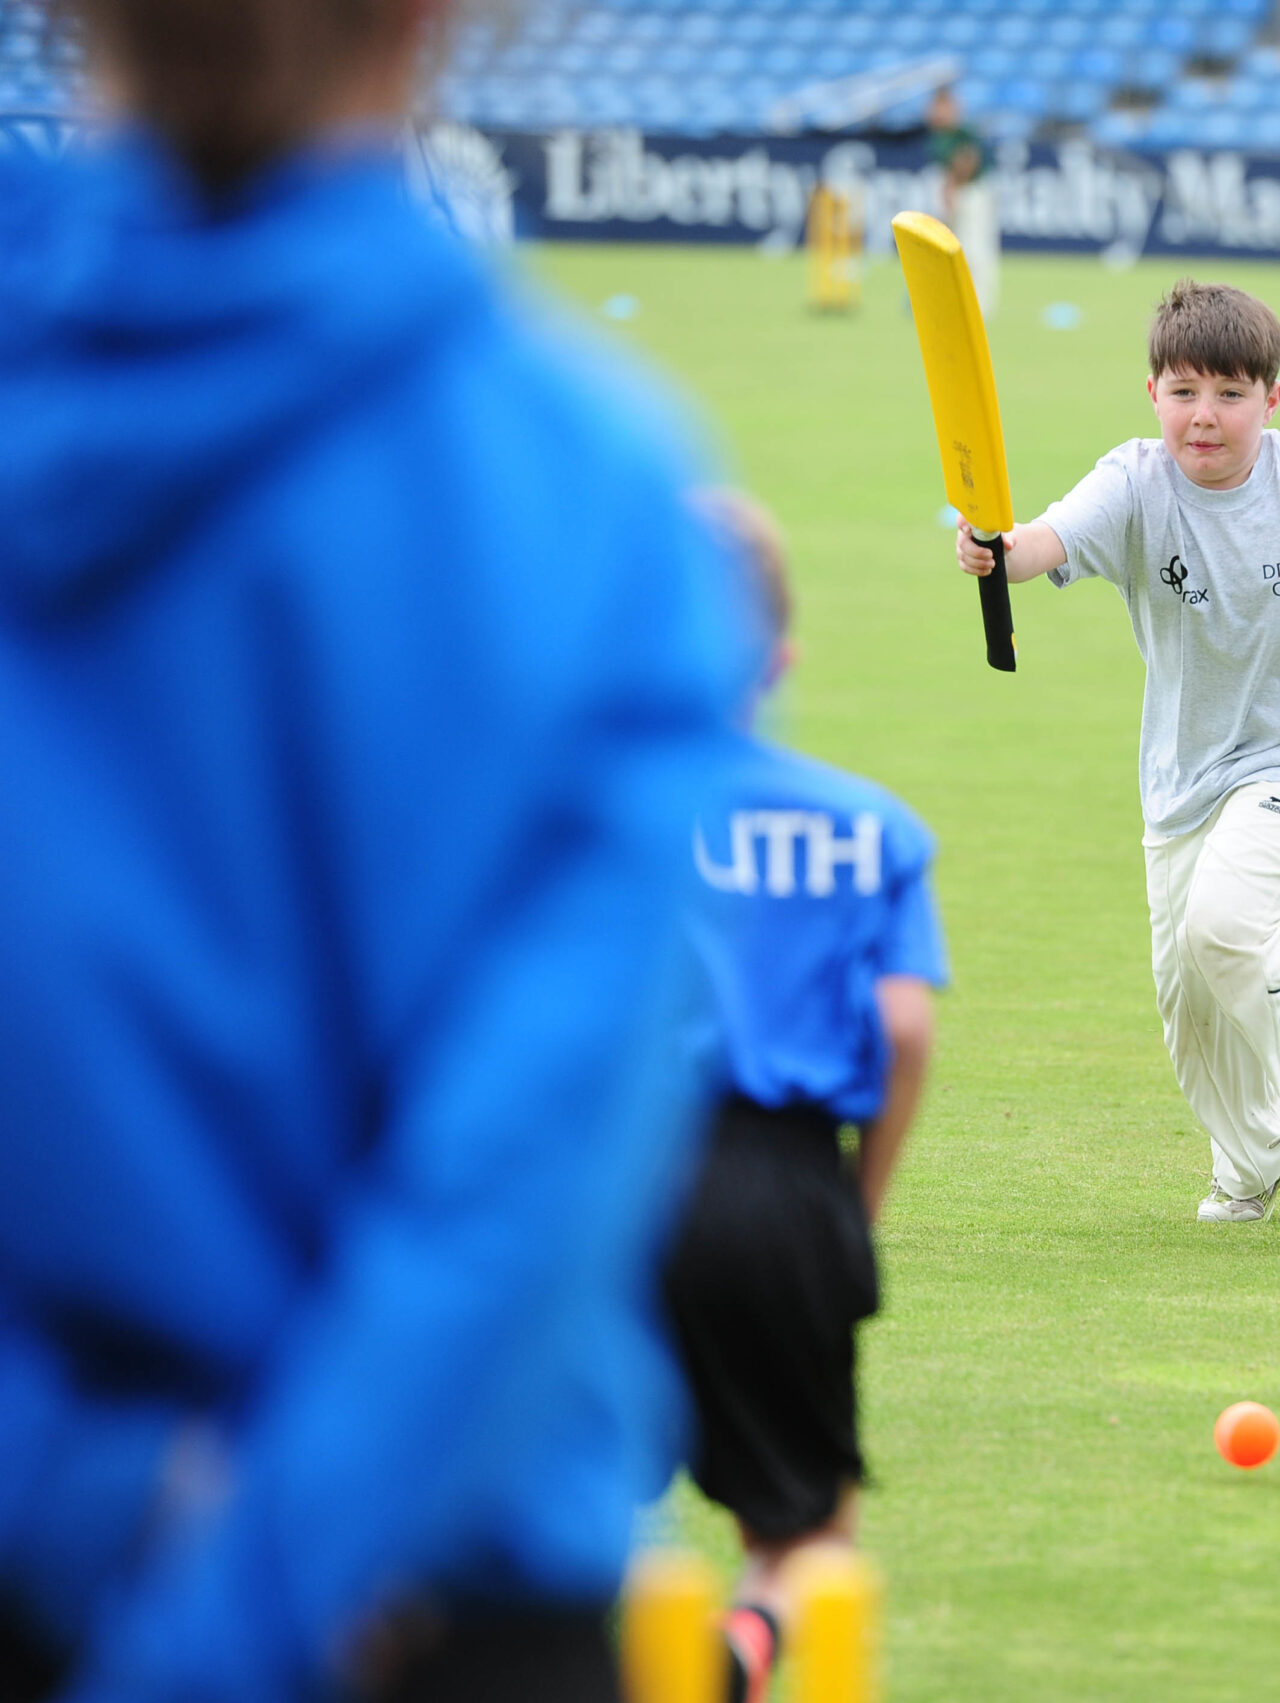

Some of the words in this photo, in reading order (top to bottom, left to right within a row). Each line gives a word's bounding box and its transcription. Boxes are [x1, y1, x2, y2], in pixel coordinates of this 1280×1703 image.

[543, 127, 817, 259] Liberty
[822, 138, 1163, 270] Speialty
[692, 808, 883, 899] UTH
